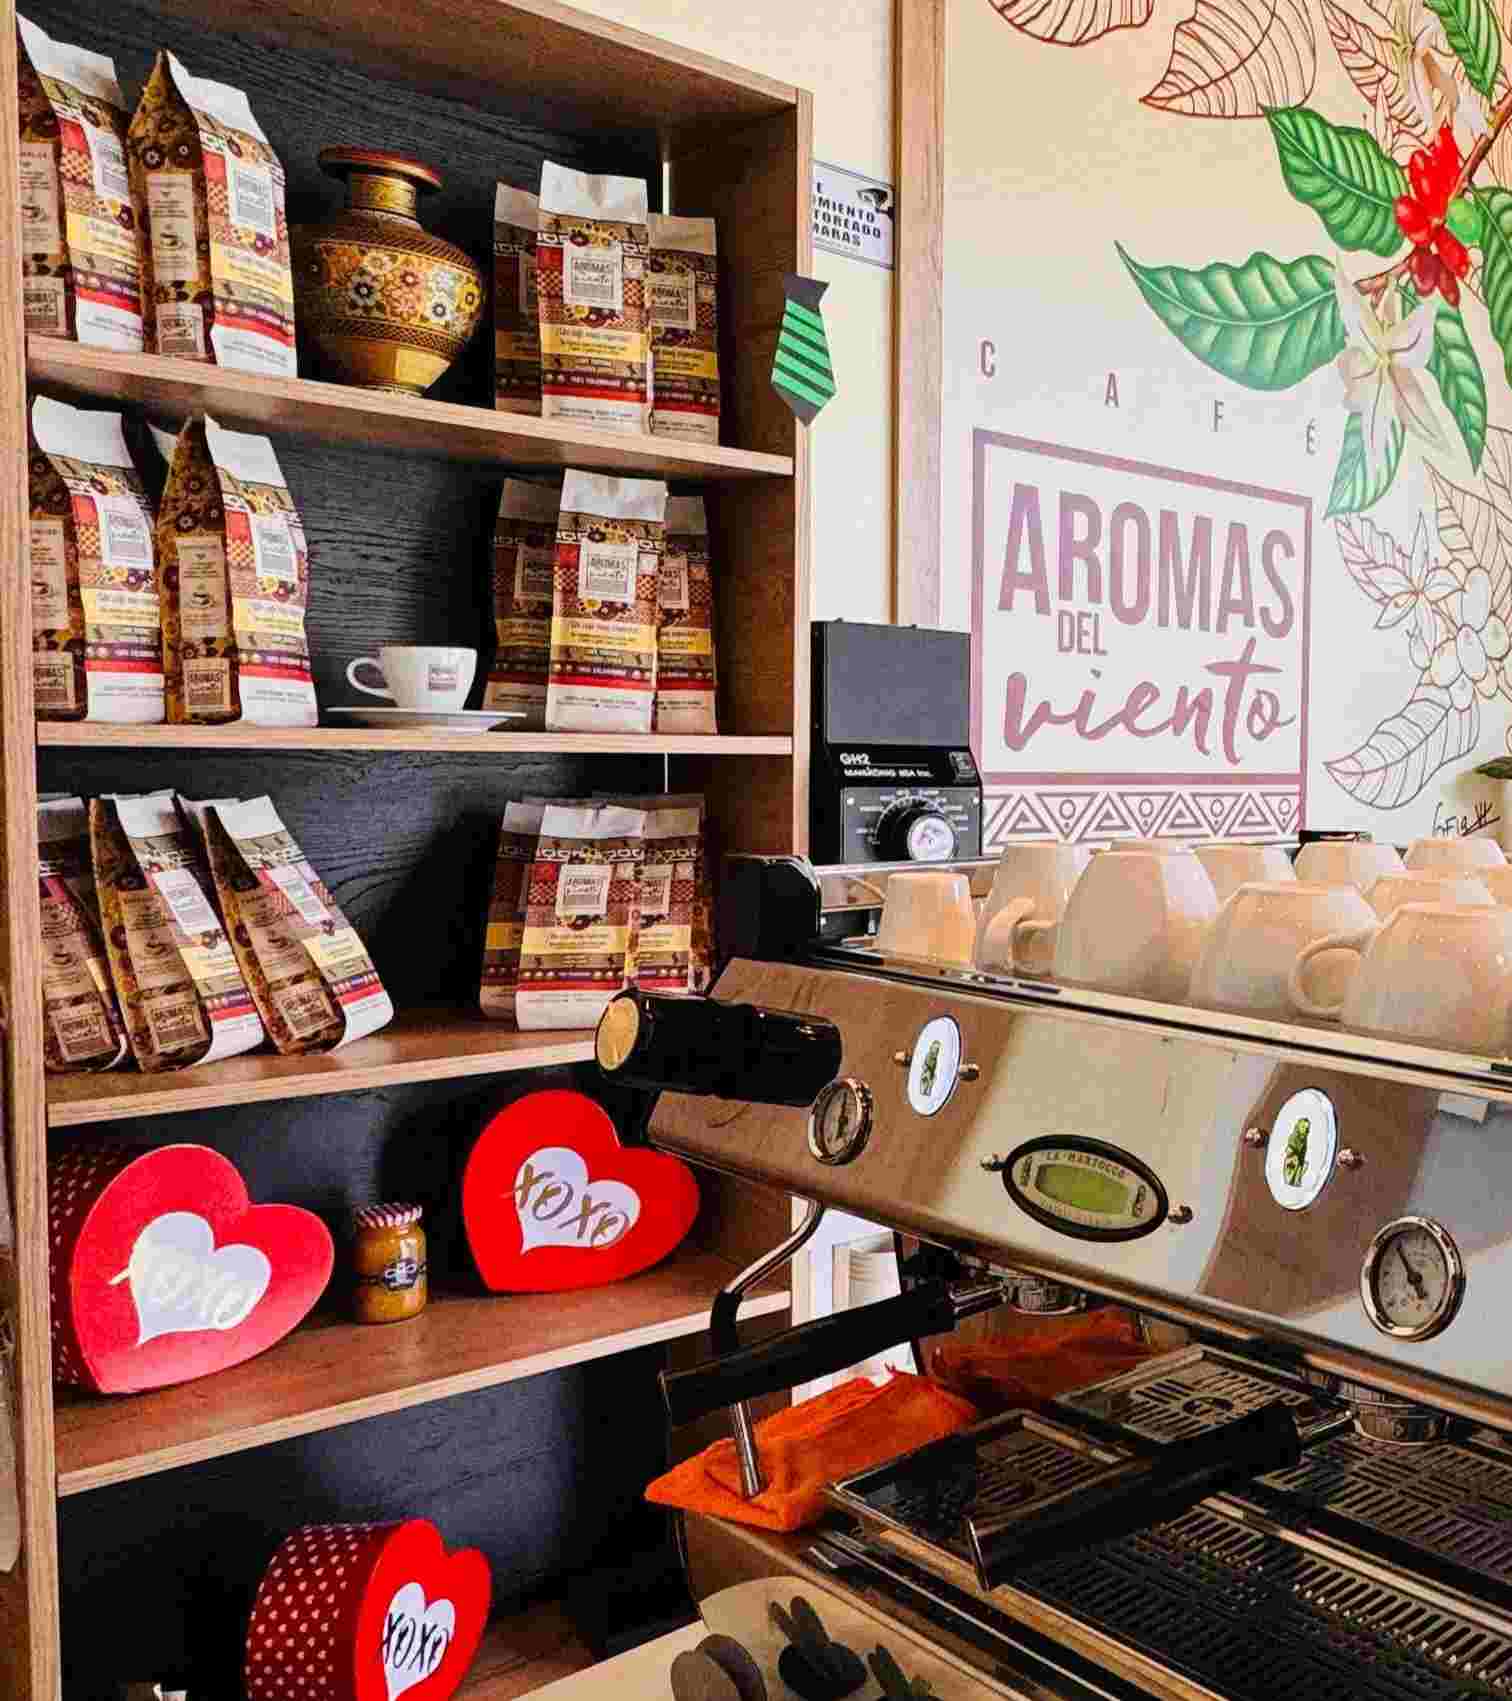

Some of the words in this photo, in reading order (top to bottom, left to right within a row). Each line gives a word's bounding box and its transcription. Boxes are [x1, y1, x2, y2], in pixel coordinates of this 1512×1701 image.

[813, 195, 875, 223] MIENTO
[998, 483, 1296, 639] AROMAS
[1057, 609, 1108, 655] DEL
[1004, 636, 1297, 766] viento
[503, 1164, 630, 1249] XOXO
[382, 1612, 449, 1674] XOXO
